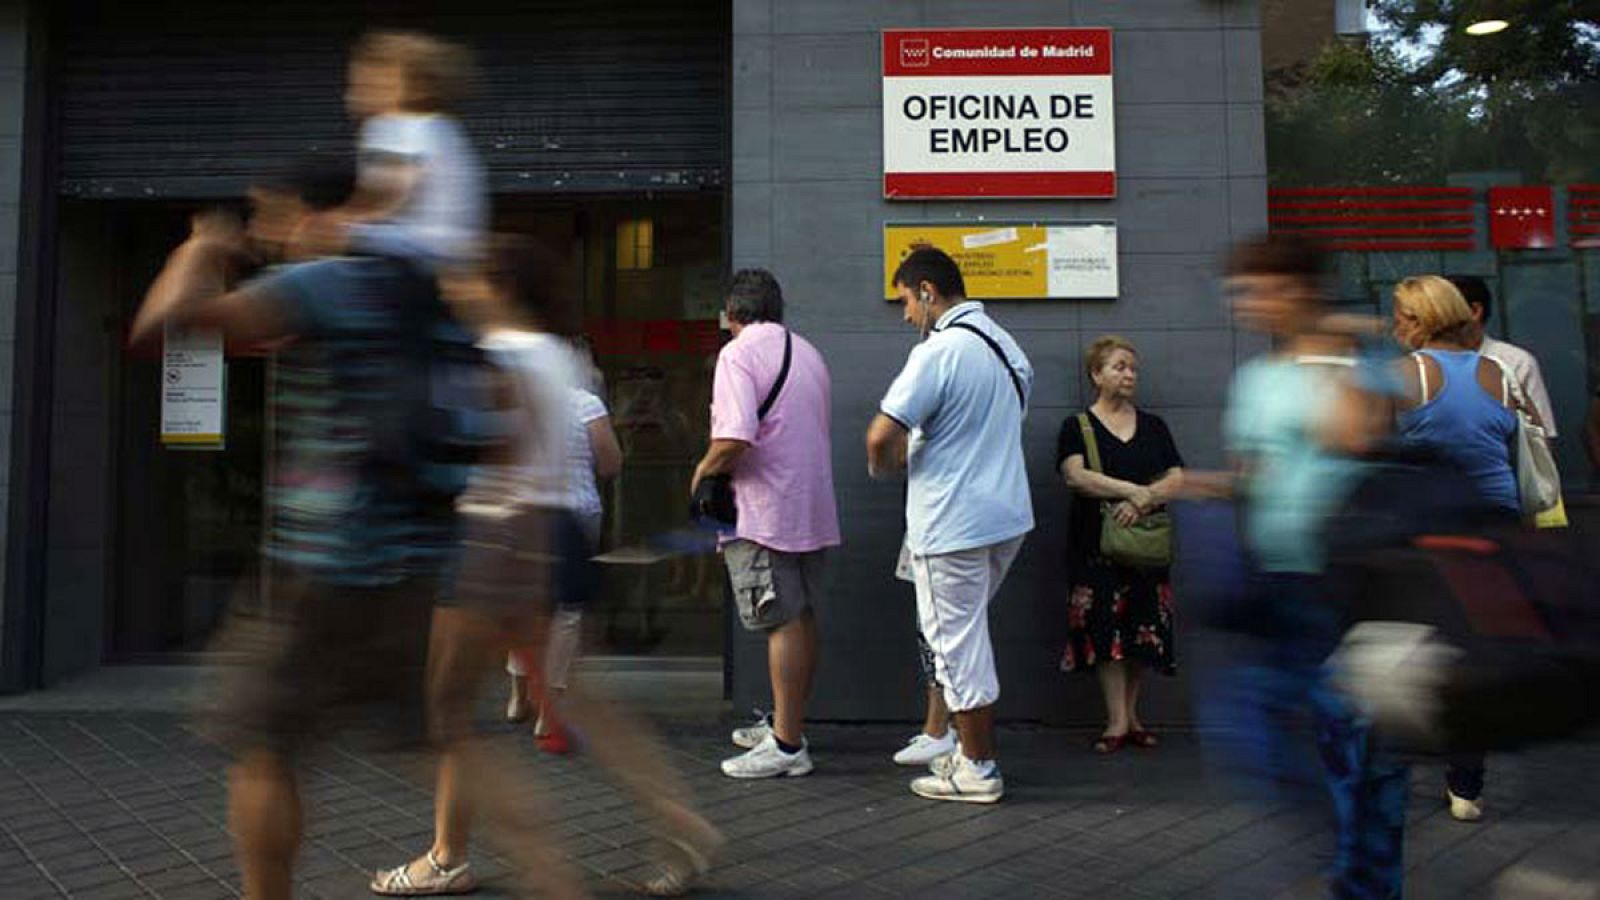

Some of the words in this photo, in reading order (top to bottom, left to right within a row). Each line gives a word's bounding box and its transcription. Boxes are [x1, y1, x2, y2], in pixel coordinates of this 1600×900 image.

[932, 45, 1017, 58] Comunidad
[1020, 46, 1039, 58] de
[1043, 45, 1094, 58] Madrid
[903, 95, 1039, 120] OFICINA
[1050, 95, 1094, 119] DE
[929, 128, 1069, 153] EMPLEO
